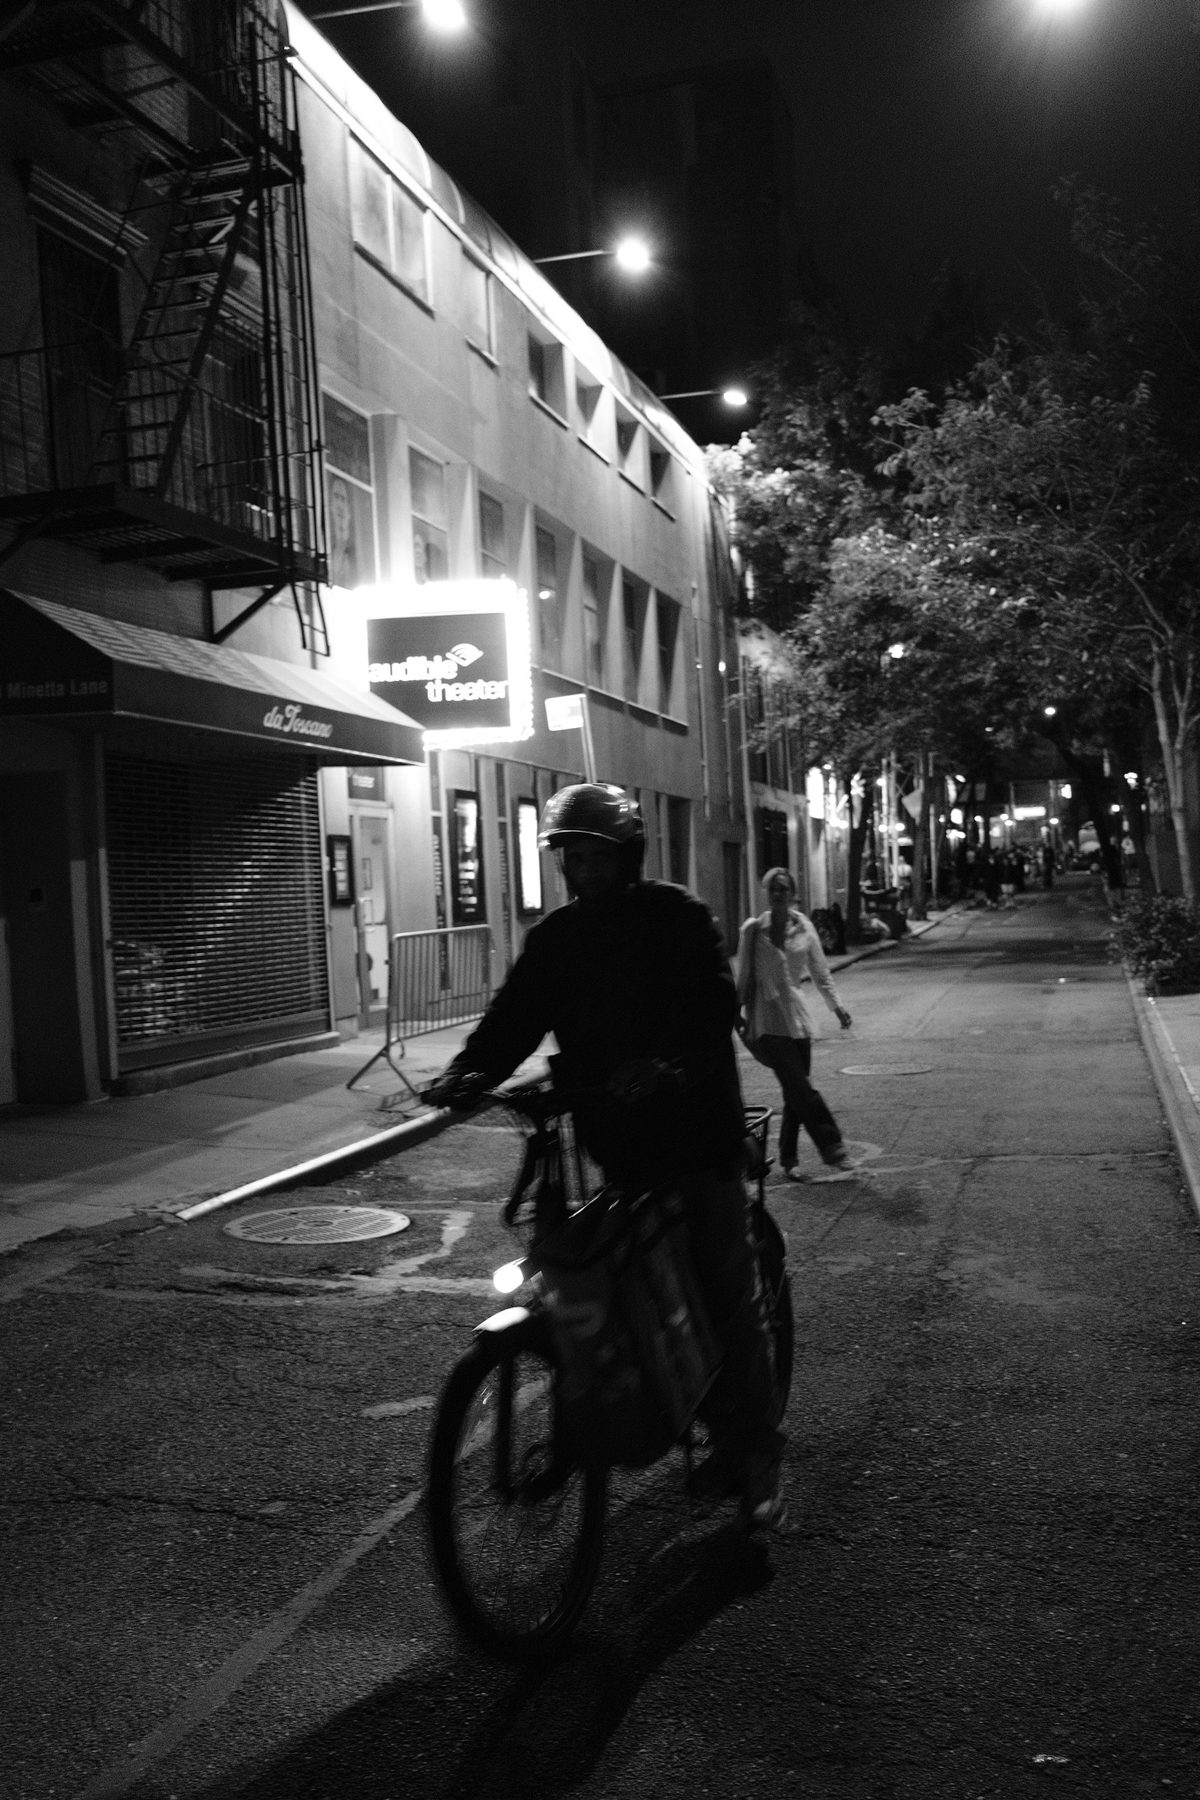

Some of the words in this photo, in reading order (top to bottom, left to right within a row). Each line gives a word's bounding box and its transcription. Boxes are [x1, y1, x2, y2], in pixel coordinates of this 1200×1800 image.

[369, 655, 458, 683] audible
[7, 680, 65, 699] Minetta
[70, 679, 108, 696] Lane
[425, 679, 510, 702] theater
[263, 706, 284, 731] da
